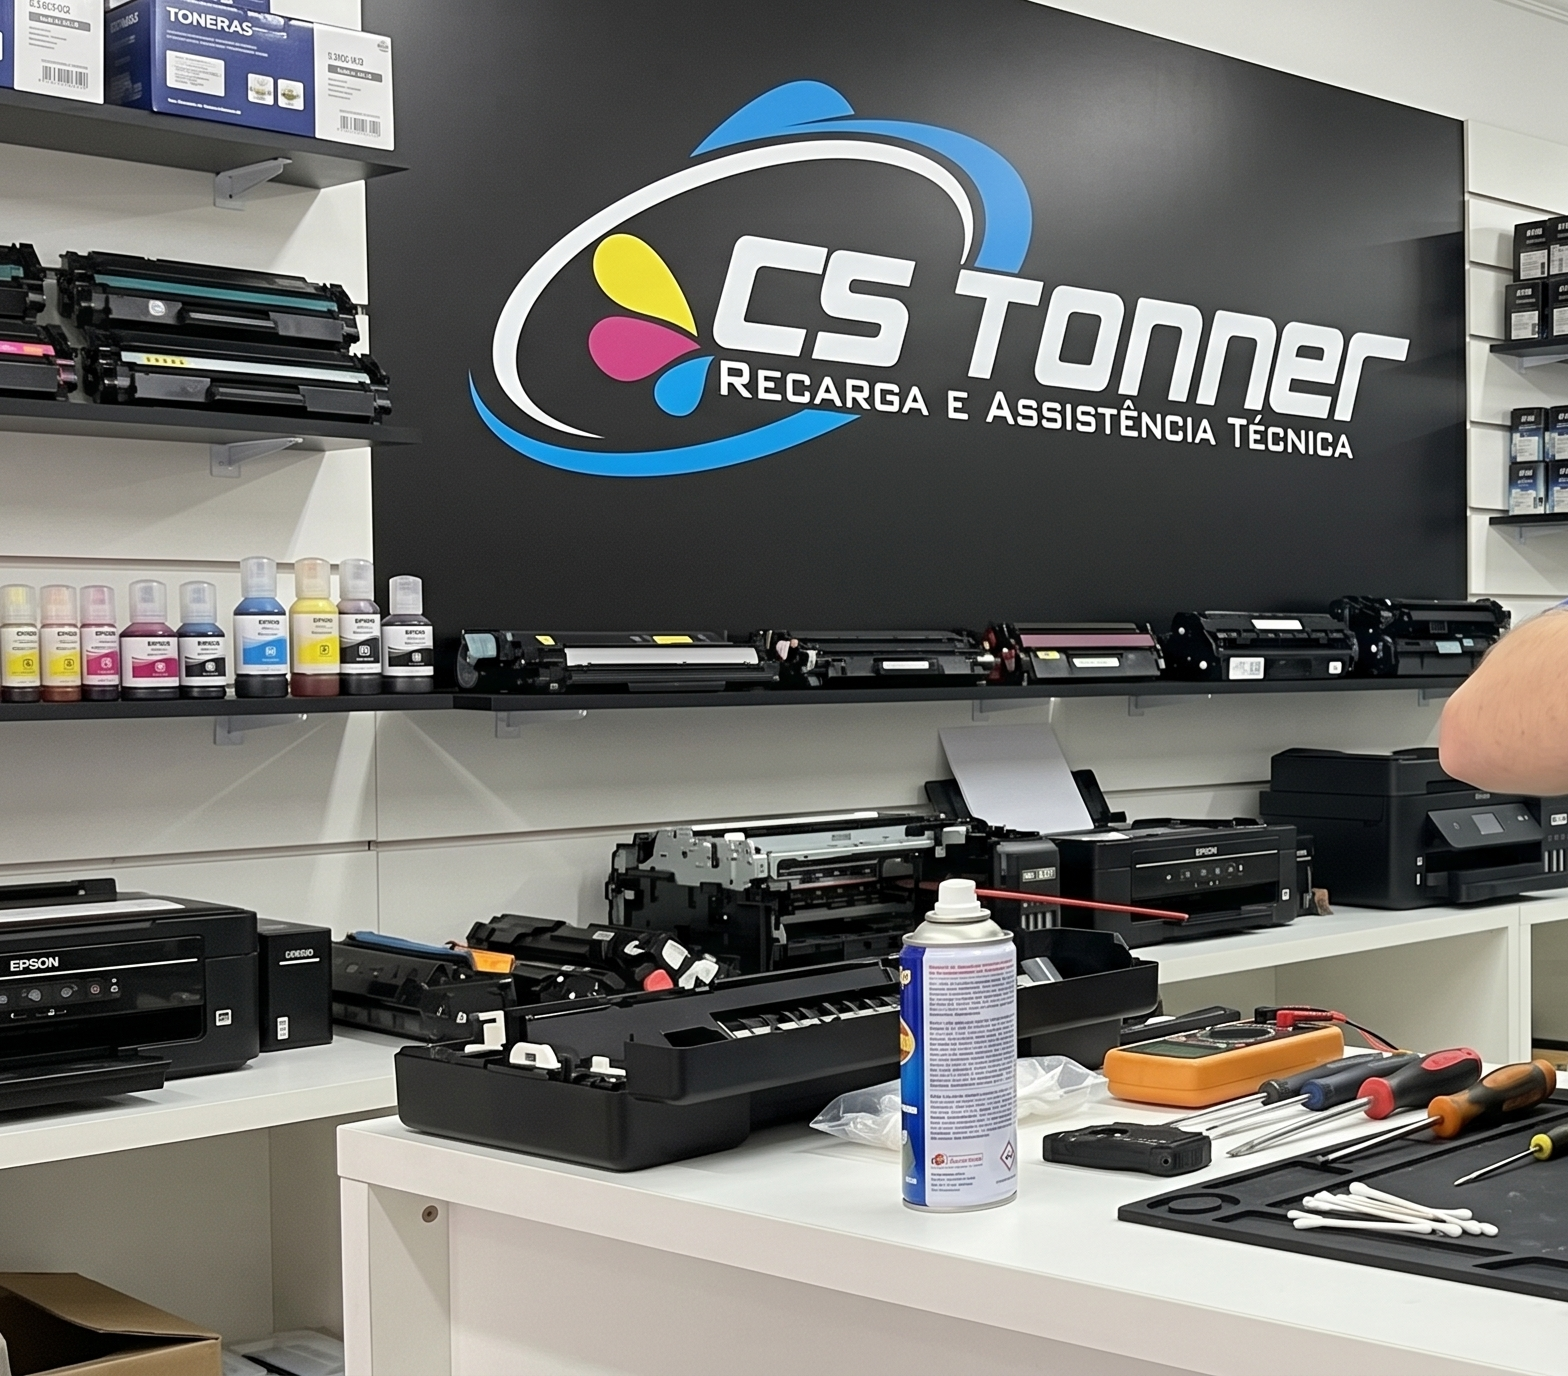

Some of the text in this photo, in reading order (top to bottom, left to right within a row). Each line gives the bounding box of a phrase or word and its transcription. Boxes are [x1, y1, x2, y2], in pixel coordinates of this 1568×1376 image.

[166, 6, 253, 37] TONERAS
[712, 235, 916, 367] CS
[720, 360, 1354, 459] RECARGA E ASSISTÊNCIA TÉCNICA
[10, 956, 59, 971] EPSON
